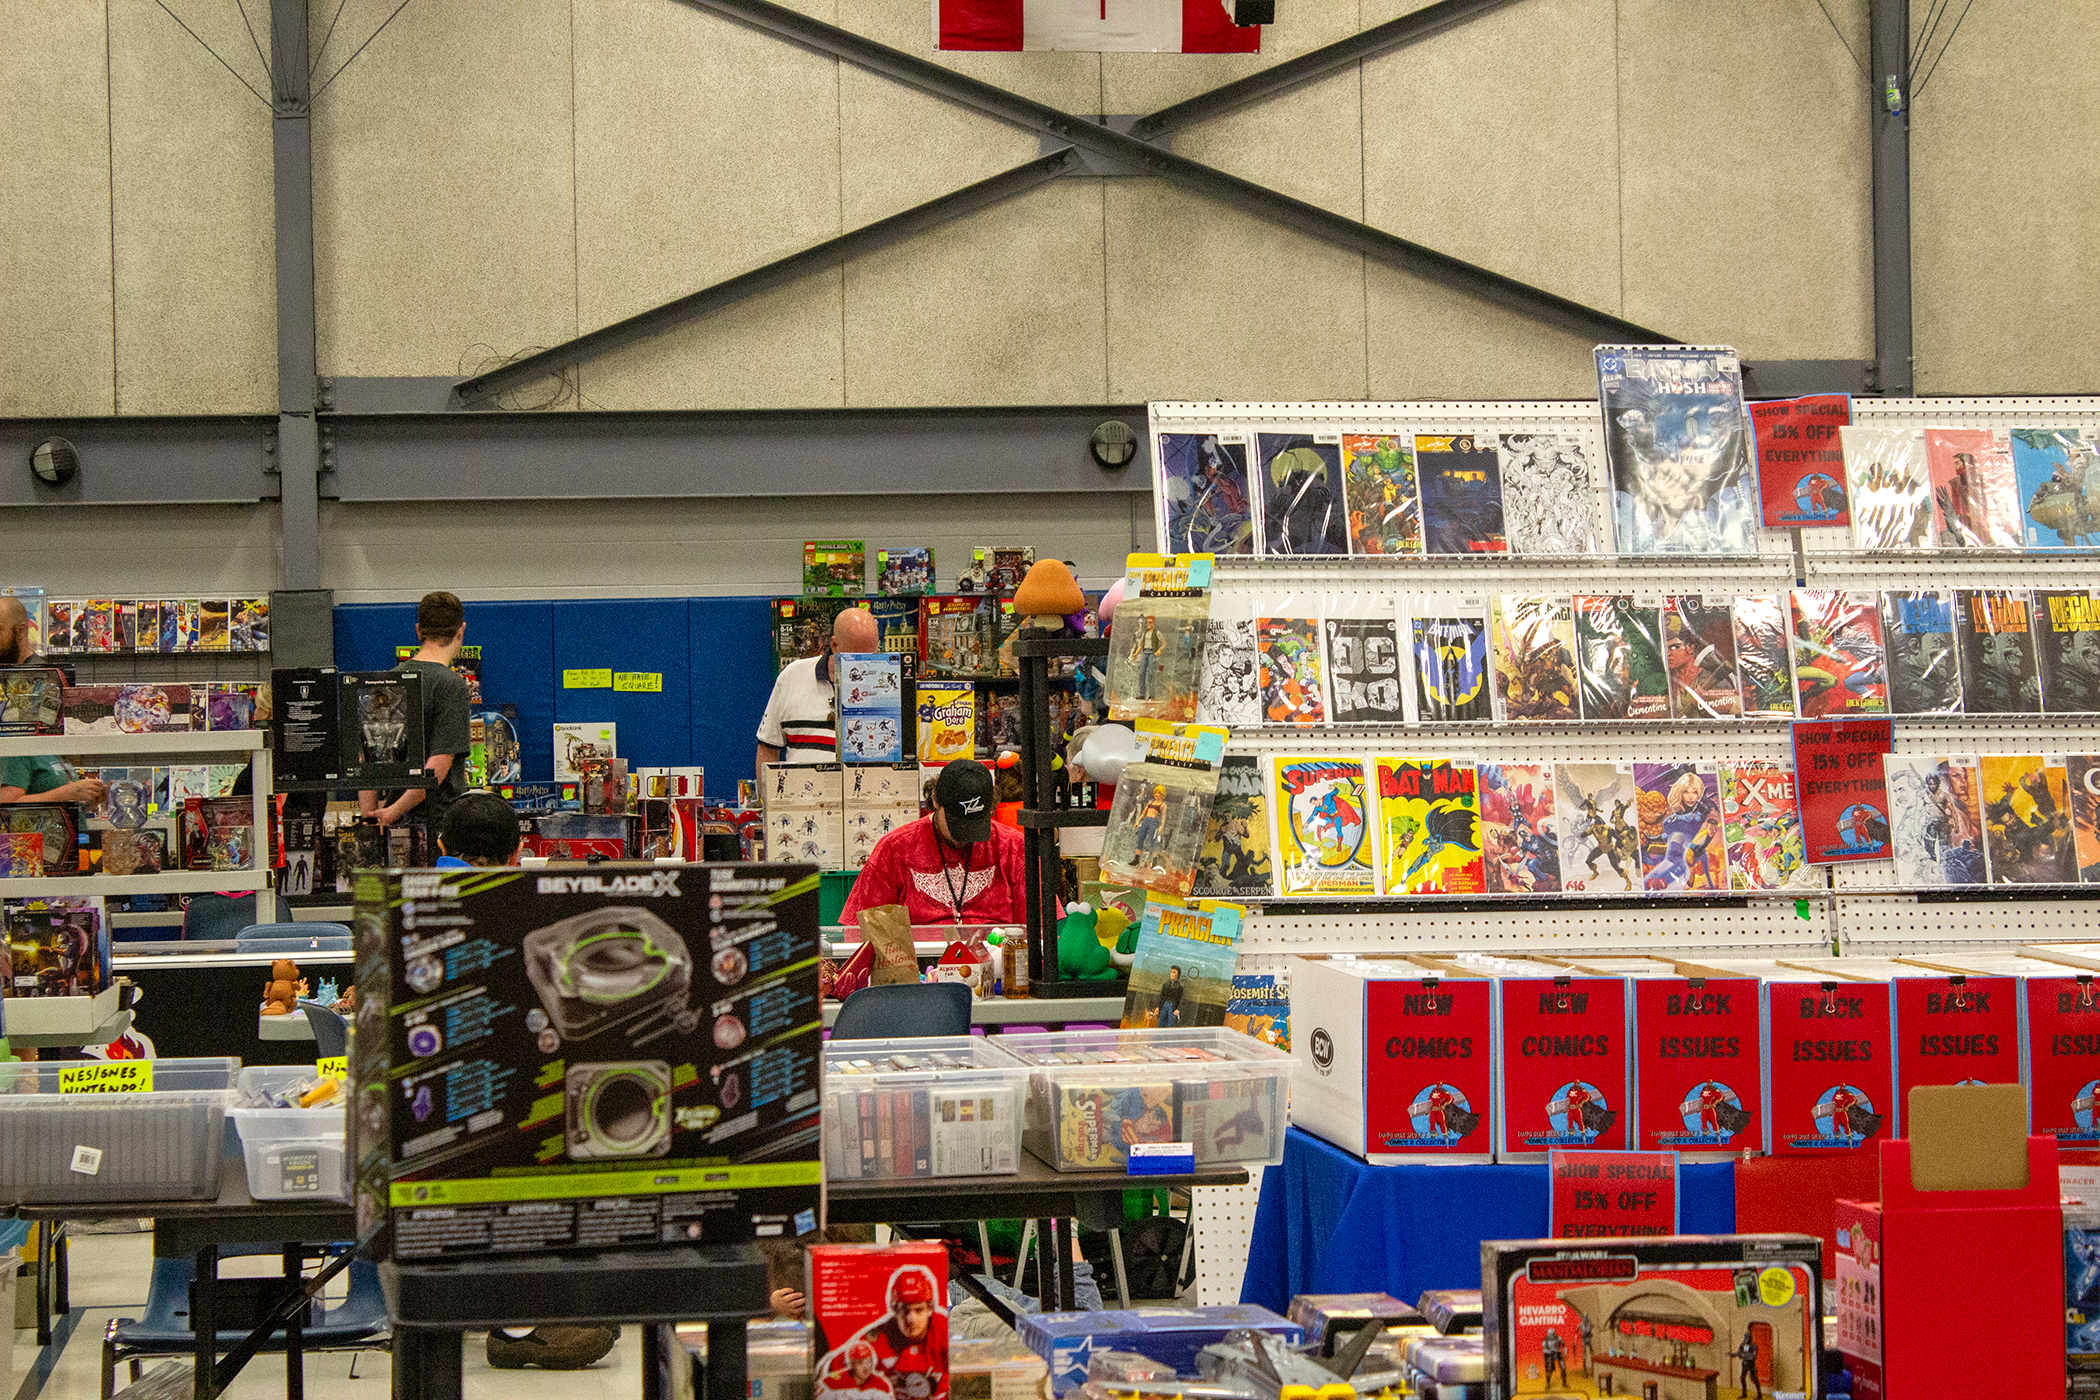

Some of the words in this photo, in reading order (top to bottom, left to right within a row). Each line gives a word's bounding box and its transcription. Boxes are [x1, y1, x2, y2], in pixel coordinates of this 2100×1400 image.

[1756, 406, 1789, 417] SHOW
[1795, 404, 1847, 415] SPECIAL
[1772, 424, 1799, 439] 15%
[1806, 424, 1836, 440] OFF
[1142, 570, 1203, 591] PREACH
[2048, 596, 2100, 622] NEGAN
[1334, 637, 1396, 674] DC
[934, 705, 973, 720] Graham
[1627, 702, 1668, 717] Clementine
[1798, 732, 1830, 745] SHOW
[1836, 730, 1888, 743] SPECIAL
[1164, 760, 1193, 768] TULIP
[1813, 754, 1840, 770] 15%
[1846, 752, 1877, 768] OFF
[1220, 774, 1265, 795] NAN
[1285, 763, 1364, 795] SUPERMA
[1740, 778, 1794, 807] X-ME
[1193, 886, 1233, 896] SCOURGE
[1240, 886, 1273, 896] SERPEN
[1158, 909, 1232, 946] PREACH
[884, 942, 902, 954] Tim
[1276, 984, 1290, 1000] SA
[1404, 994, 1454, 1016] NEW
[1539, 992, 1589, 1014] NEW
[1666, 993, 1732, 1016] BACK
[1800, 997, 1863, 1019] BACK
[1926, 992, 1991, 1014] BACK
[2058, 992, 2100, 1014] BAC
[1315, 1036, 1330, 1058] BCW
[1385, 1036, 1473, 1059] COMICS
[1522, 1035, 1609, 1057] COMICS
[1660, 1036, 1740, 1059] ISSUES
[1793, 1040, 1872, 1062] ISSUES
[1920, 1034, 1999, 1056] ISSUES
[1075, 1097, 1100, 1163] SUPERMAN
[1558, 1163, 1600, 1178] SHOW
[1607, 1165, 1672, 1180] SPECIAL
[1575, 1190, 1609, 1210] 15%
[1617, 1191, 1657, 1211] OFF
[1562, 1223, 1668, 1238] EVERYTHING
[1519, 1304, 1566, 1315] NEVARRO
[1519, 1315, 1565, 1326] CANTINA
